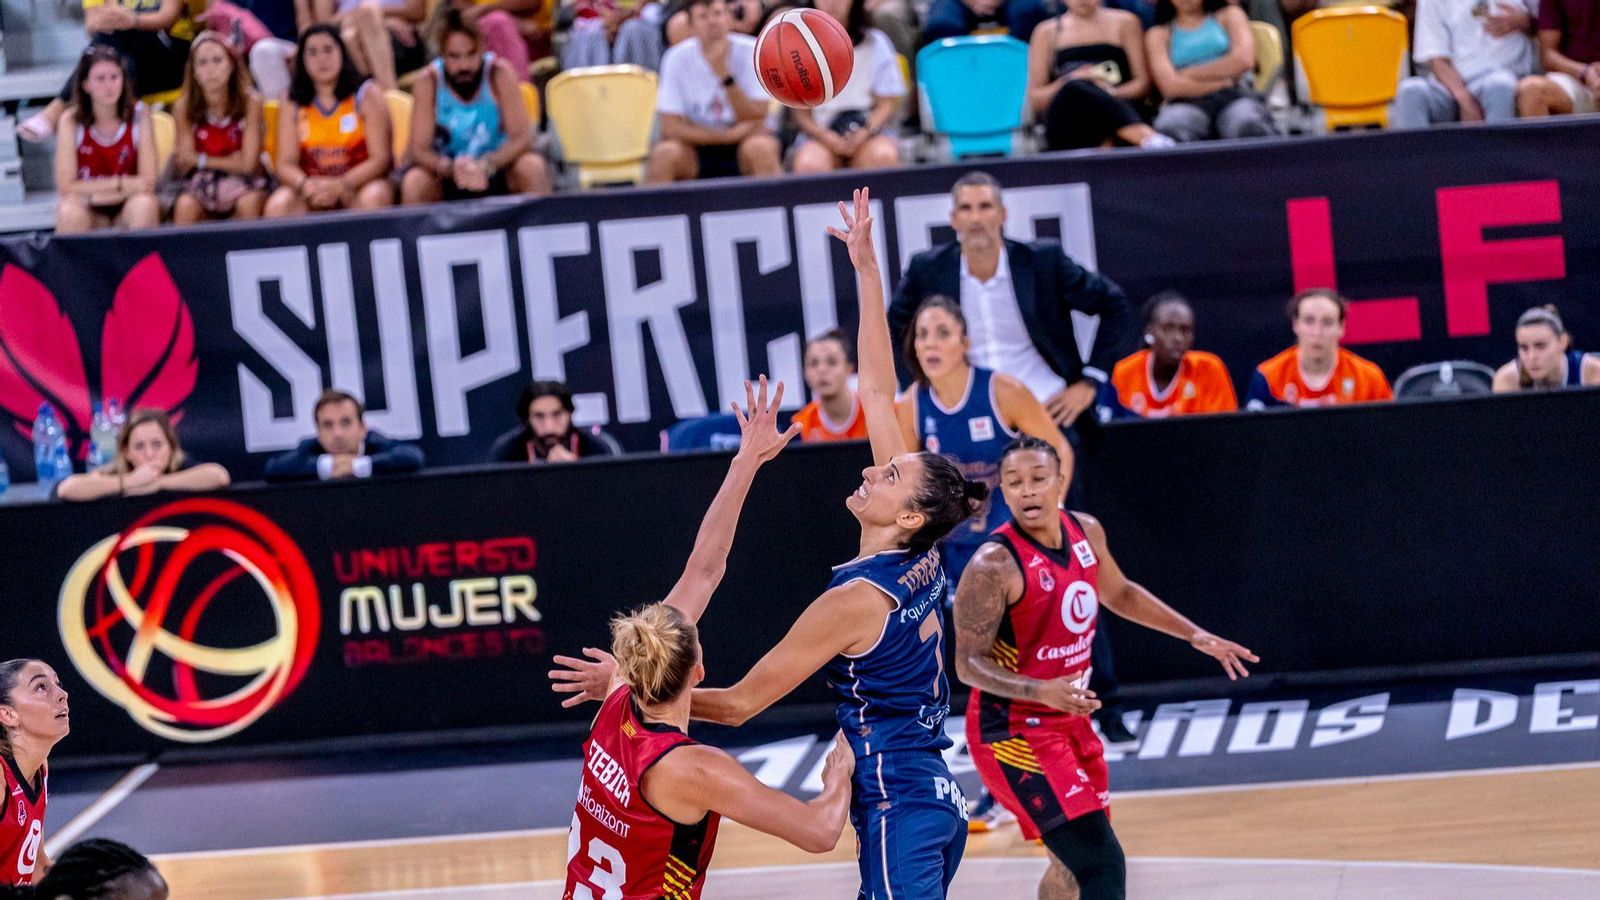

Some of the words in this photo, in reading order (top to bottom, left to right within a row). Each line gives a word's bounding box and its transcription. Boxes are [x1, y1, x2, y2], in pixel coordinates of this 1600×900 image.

[790, 50, 813, 92] molten
[333, 535, 538, 583] UNIVERSO
[339, 574, 543, 635] MUJER
[918, 607, 944, 700] 7
[1445, 678, 1600, 742] DE
